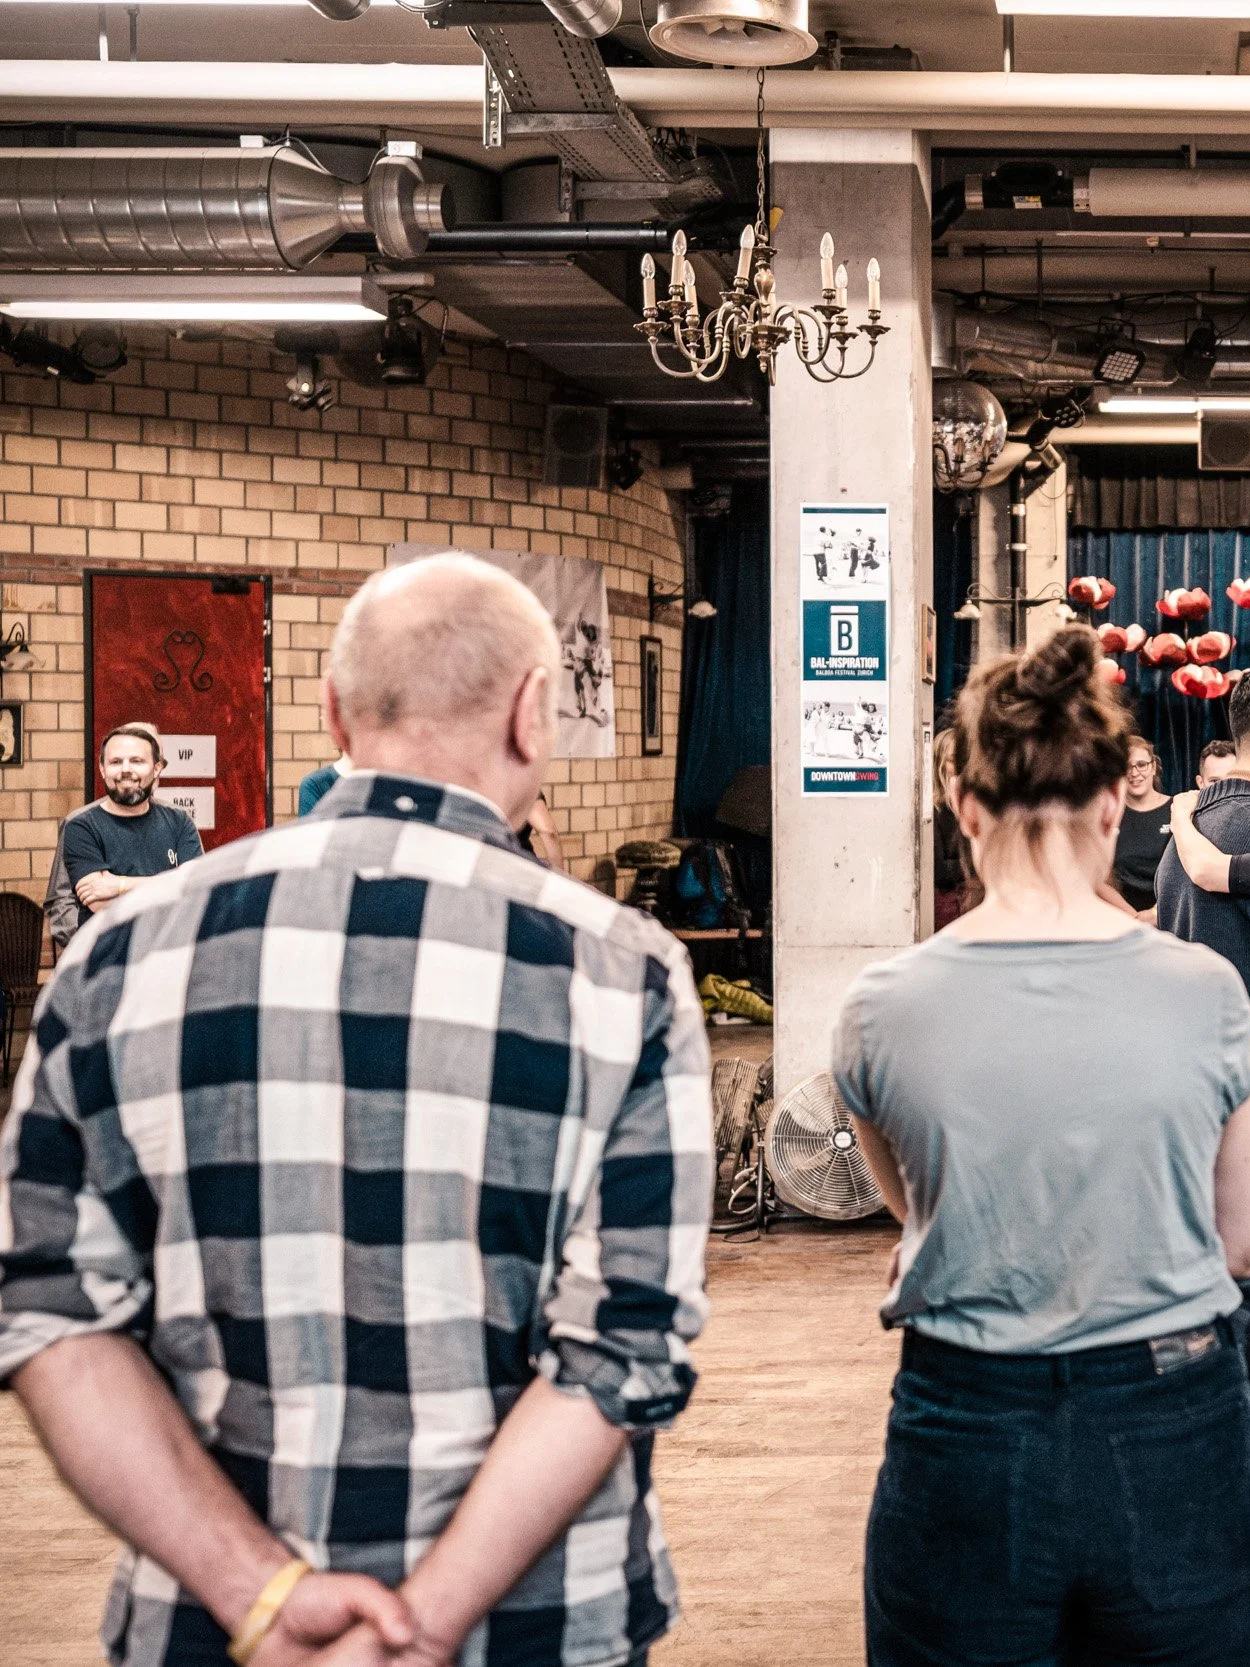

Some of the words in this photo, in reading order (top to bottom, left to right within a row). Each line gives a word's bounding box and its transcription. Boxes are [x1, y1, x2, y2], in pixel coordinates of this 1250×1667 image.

[811, 657, 879, 669] BAL-INSPIRATION
[178, 749, 194, 760] VIP
[811, 771, 879, 781] DOWNTOWNSWING
[173, 797, 195, 807] BACK
